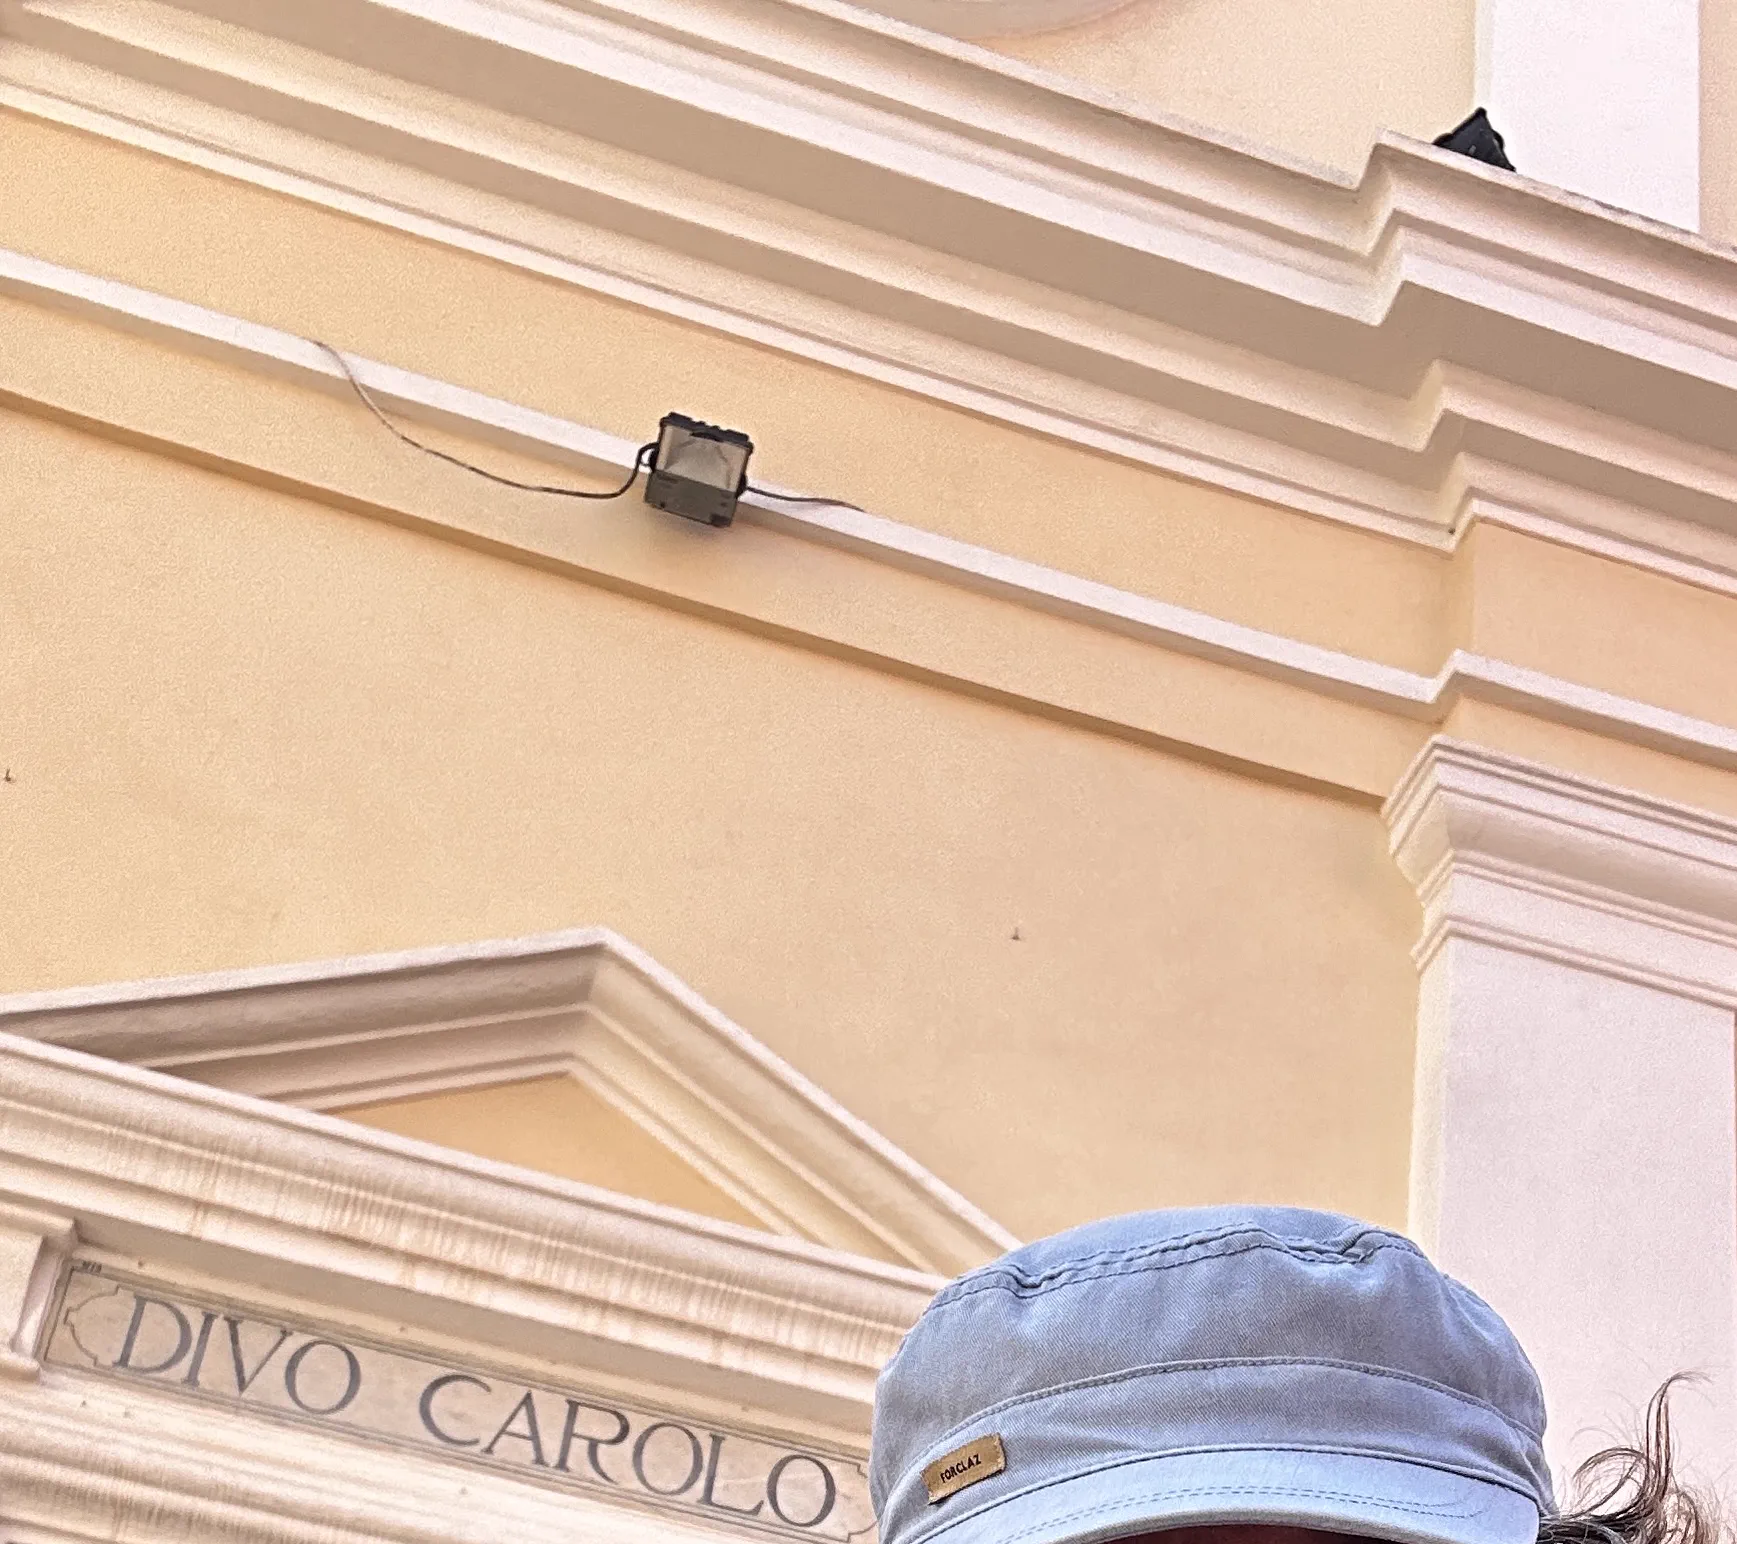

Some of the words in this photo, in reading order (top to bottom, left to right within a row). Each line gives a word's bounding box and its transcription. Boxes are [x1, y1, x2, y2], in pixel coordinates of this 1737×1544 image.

[110, 1294, 361, 1415] DIVO
[418, 1373, 838, 1528] CAROLO
[940, 1453, 982, 1483] FORCLAZ
